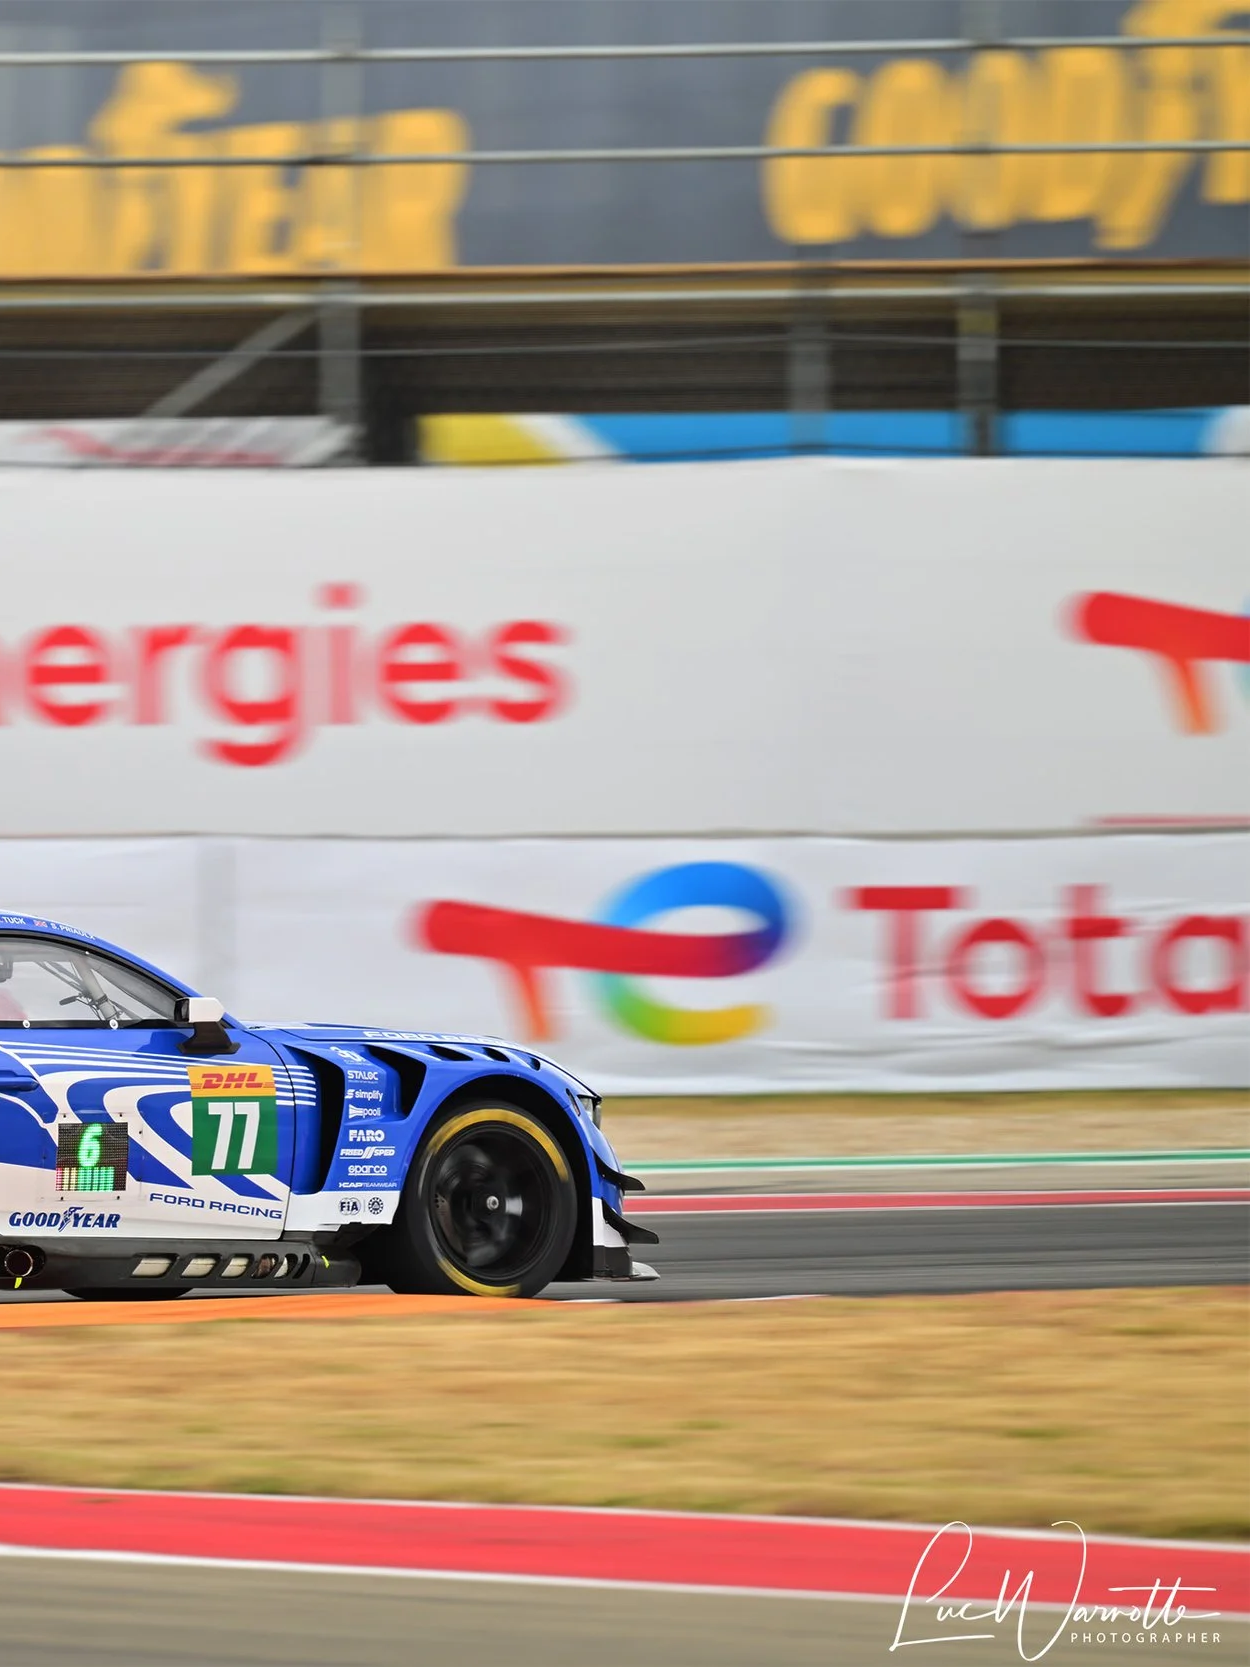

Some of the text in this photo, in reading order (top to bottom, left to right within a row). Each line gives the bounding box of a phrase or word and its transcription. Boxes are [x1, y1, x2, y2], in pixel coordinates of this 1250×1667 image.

[2, 916, 26, 925] TUCK
[201, 1072, 263, 1089] DHL
[347, 1070, 379, 1081] STALOC
[355, 1089, 383, 1102] simplify
[208, 1101, 260, 1170] 77
[349, 1129, 385, 1142] FARO
[77, 1122, 103, 1168] 6
[348, 1165, 387, 1175] sparco
[150, 1192, 283, 1219] FORD RACING
[8, 1207, 121, 1232] GOODYEAR
